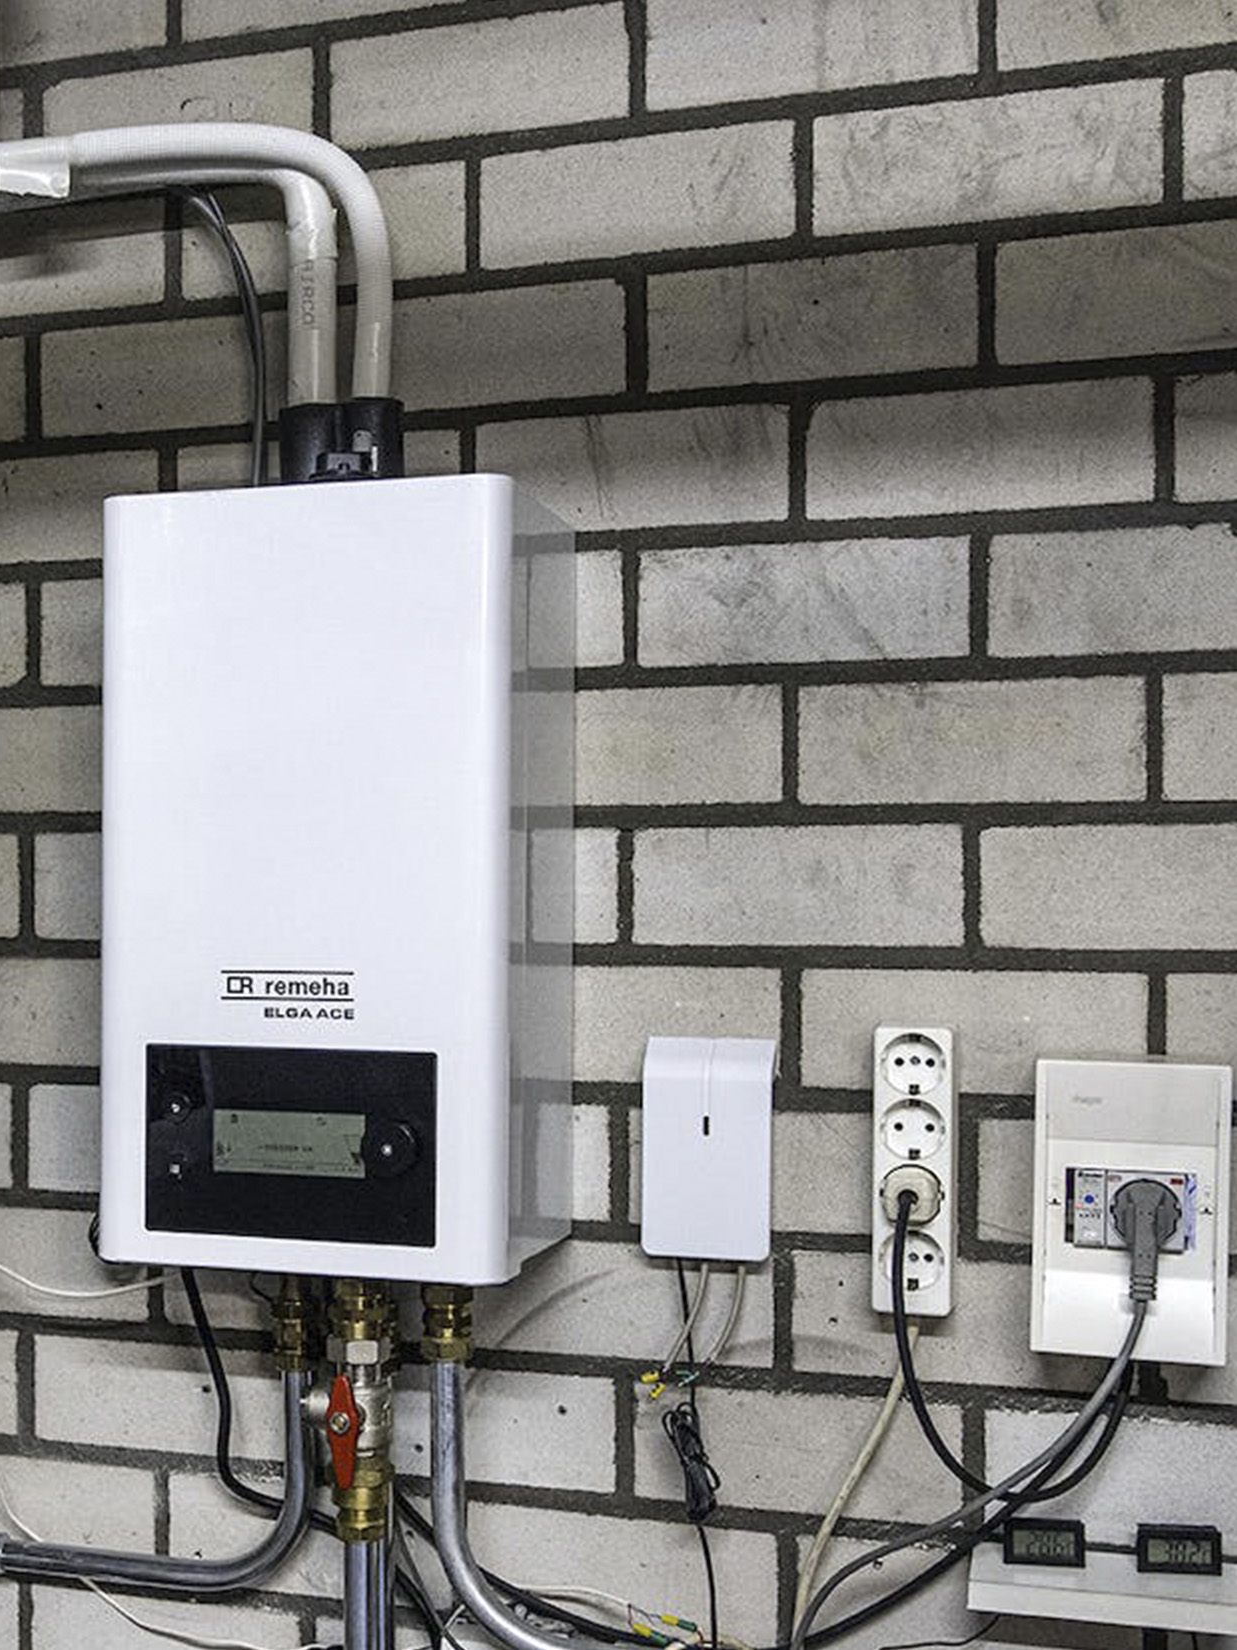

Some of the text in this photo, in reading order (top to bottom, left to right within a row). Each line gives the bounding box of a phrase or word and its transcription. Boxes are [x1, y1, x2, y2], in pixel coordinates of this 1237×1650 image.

[265, 977, 349, 996] remeha
[263, 1007, 355, 1020] ELGA ACE
